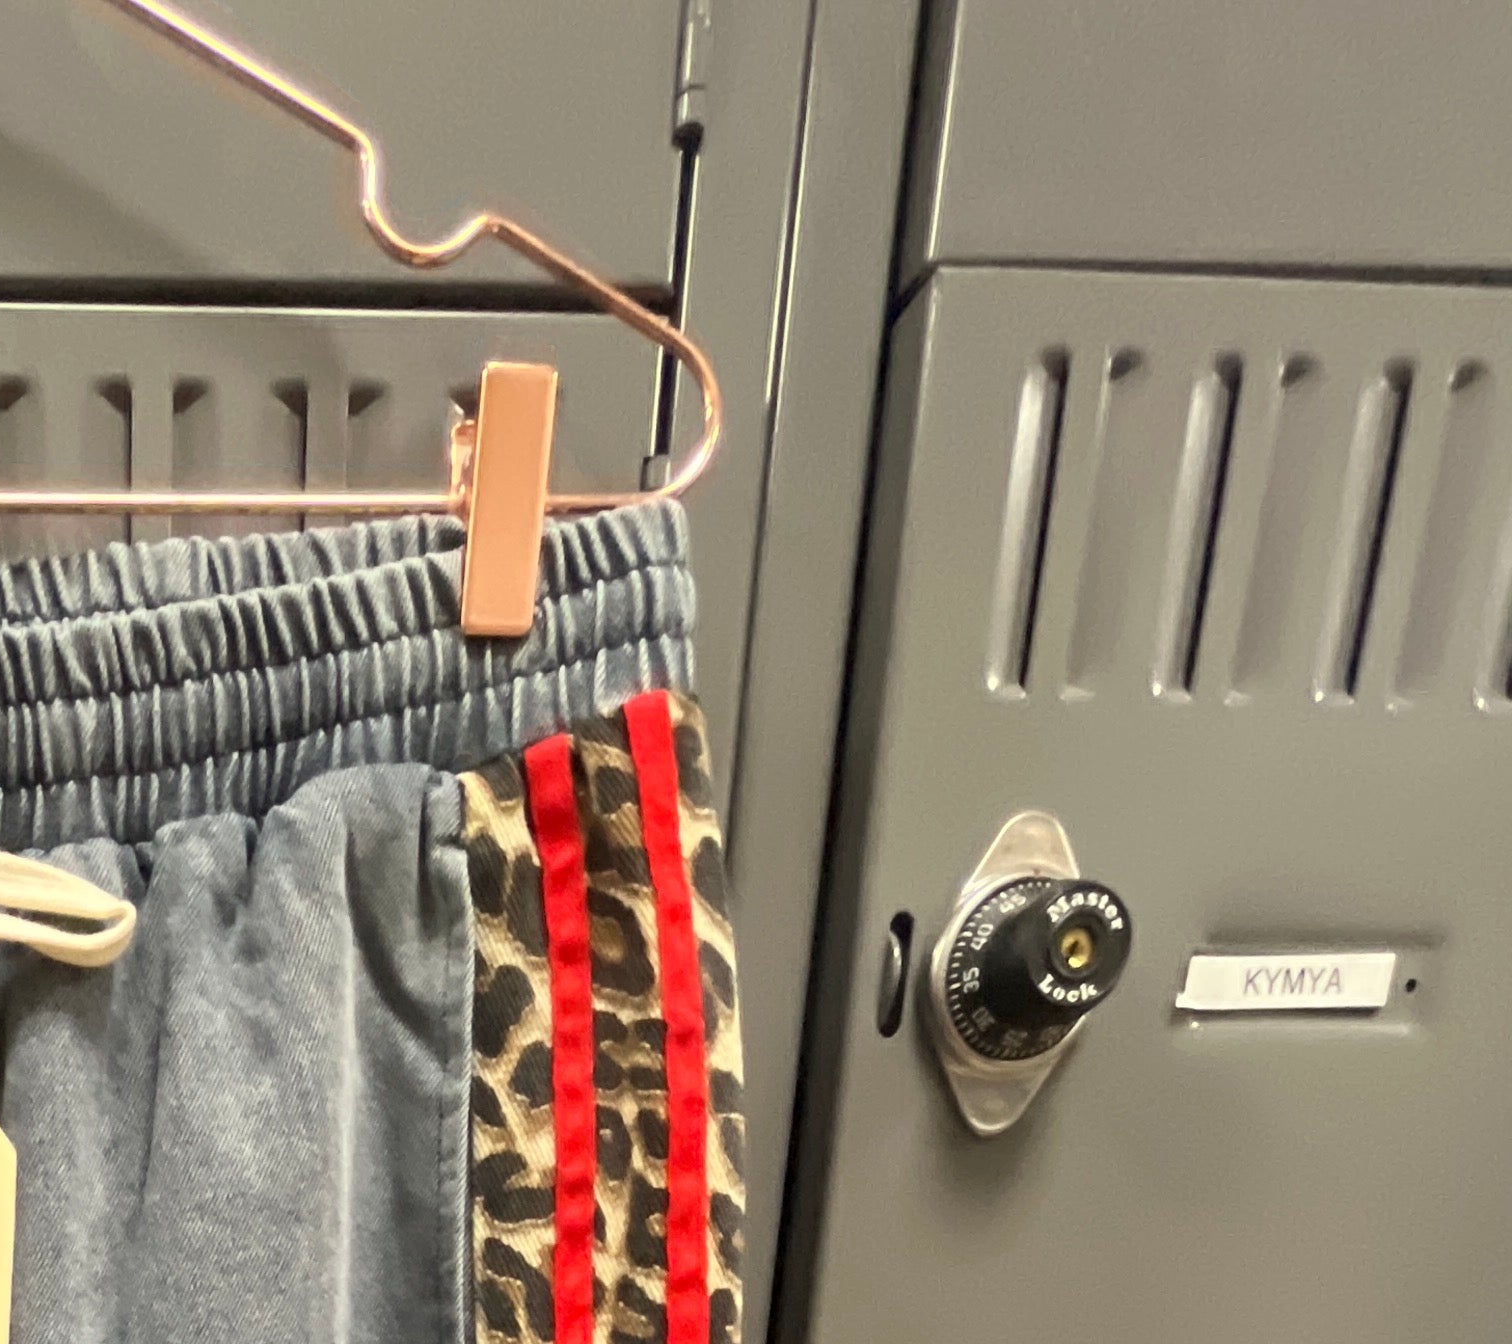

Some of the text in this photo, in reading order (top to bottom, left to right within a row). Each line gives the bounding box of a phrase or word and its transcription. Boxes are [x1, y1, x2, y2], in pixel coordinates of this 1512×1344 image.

[1046, 892, 1123, 930] Master
[970, 923, 994, 951] 40
[963, 967, 980, 994] 35
[1037, 973, 1098, 1003] Lock
[1243, 967, 1343, 995] KYMYA
